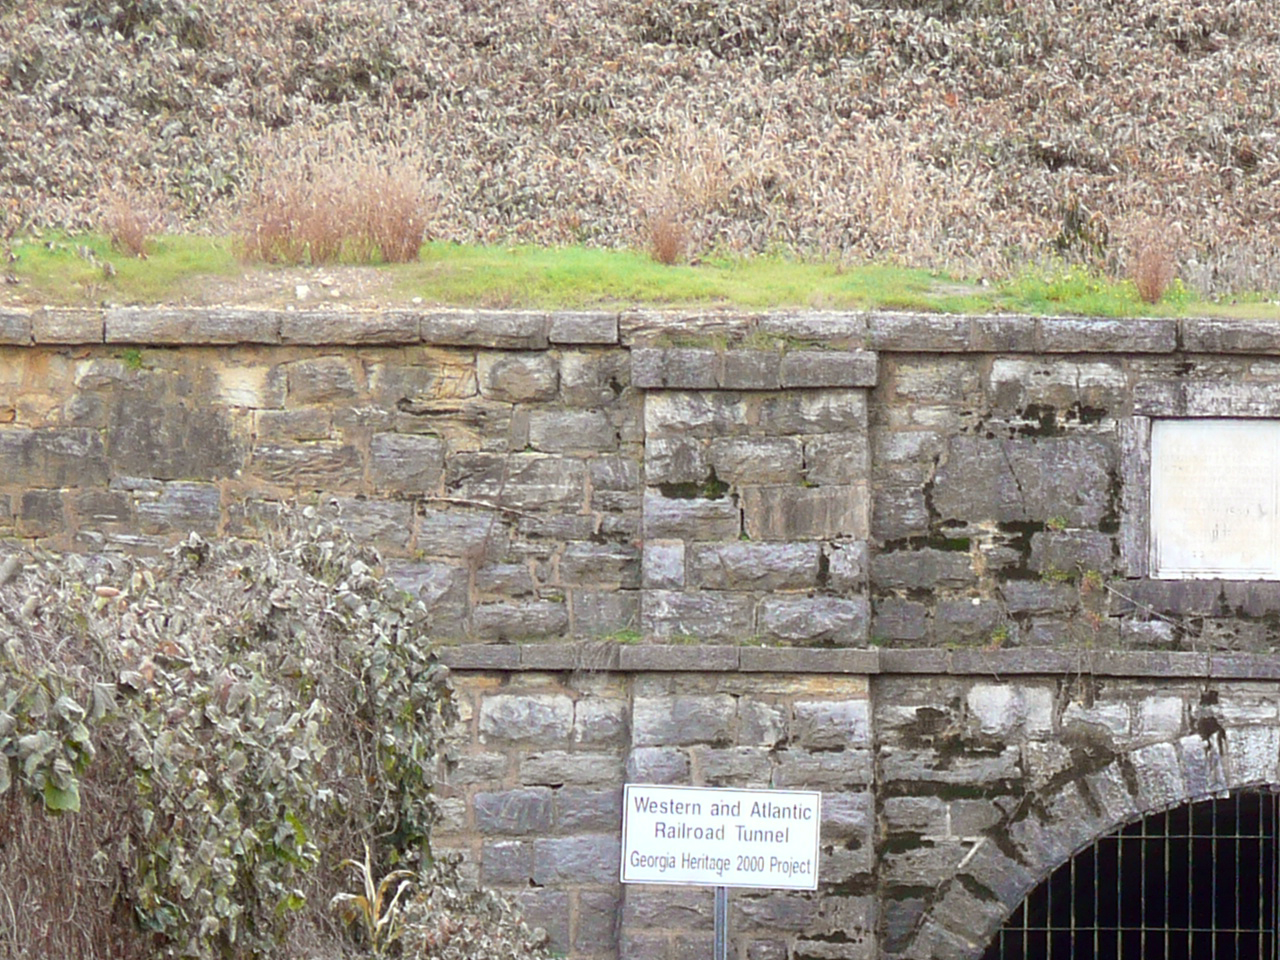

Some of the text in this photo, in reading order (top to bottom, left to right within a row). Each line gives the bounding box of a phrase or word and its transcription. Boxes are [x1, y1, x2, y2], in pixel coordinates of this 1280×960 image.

[634, 796, 812, 820] Western and Atlantic
[654, 822, 789, 843] Railroad Tunnel
[630, 850, 811, 877] Georgia Heritage 2000 Project
